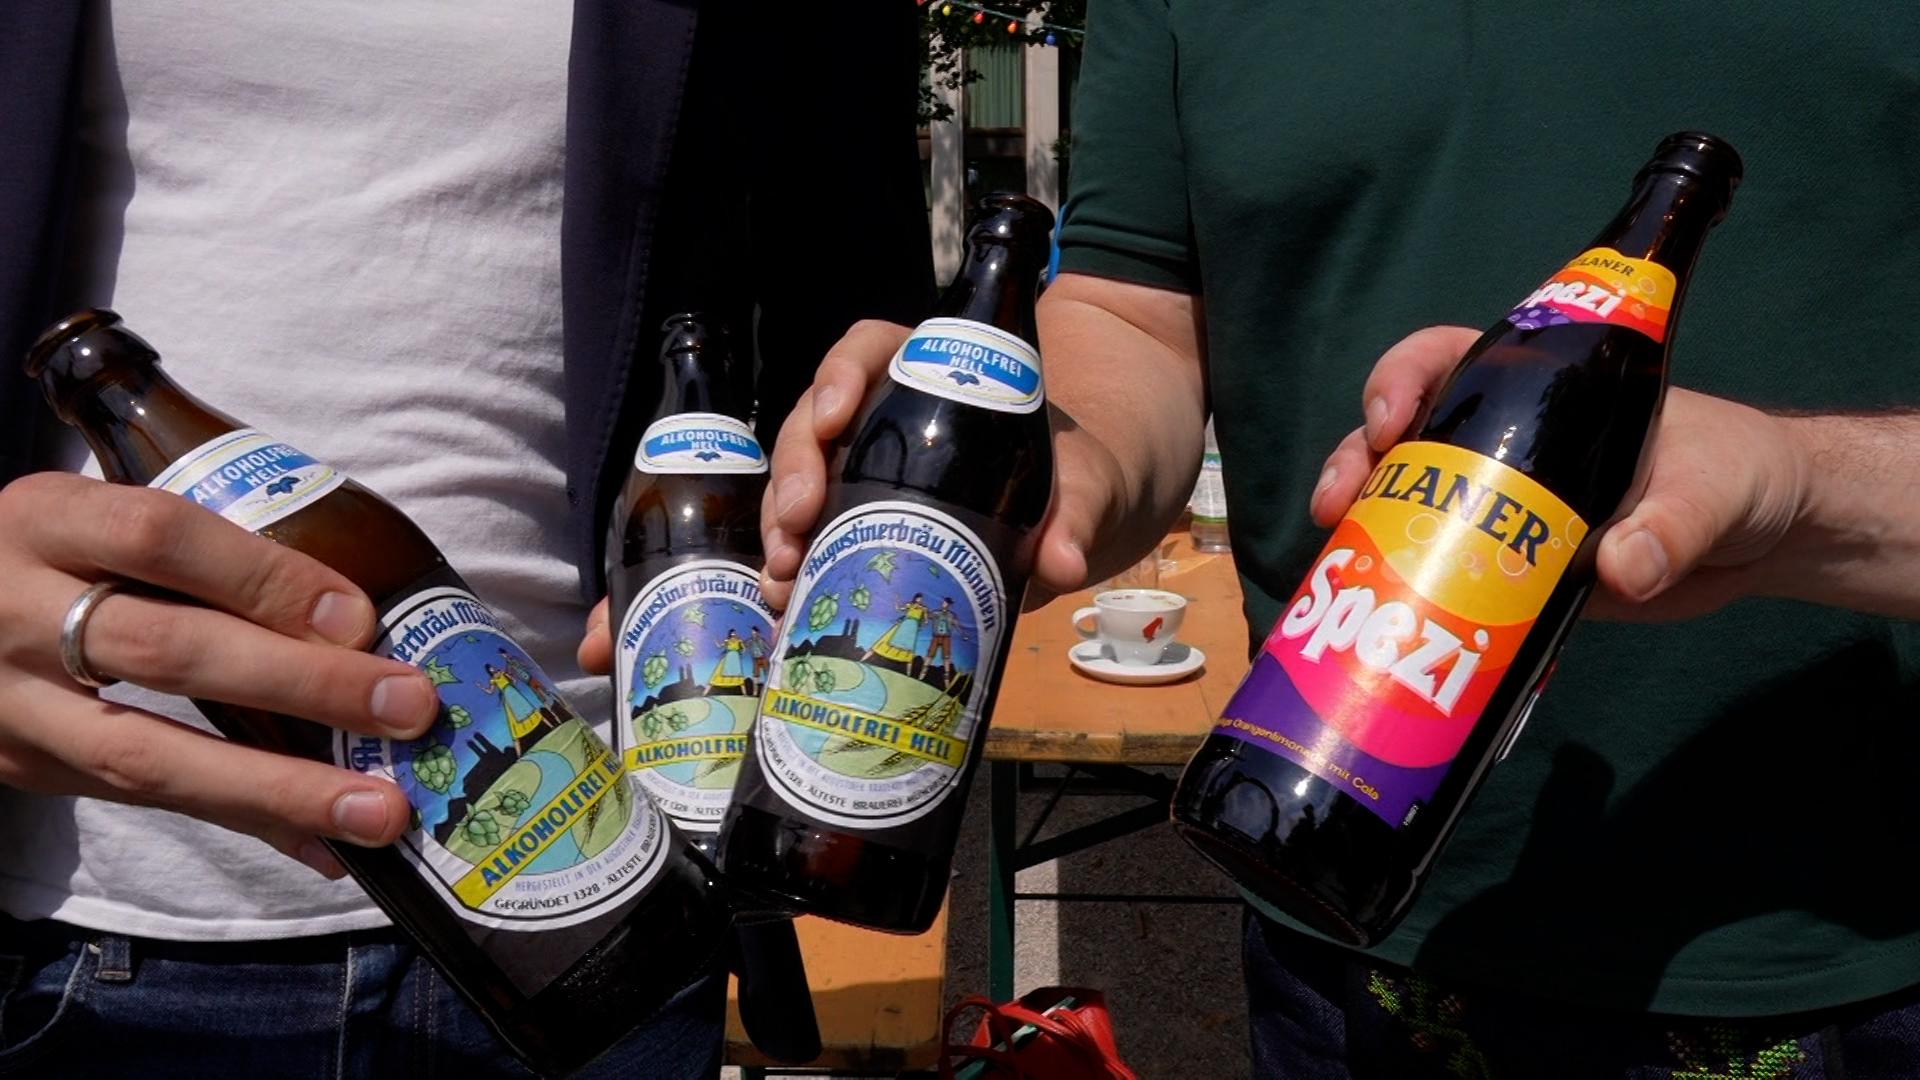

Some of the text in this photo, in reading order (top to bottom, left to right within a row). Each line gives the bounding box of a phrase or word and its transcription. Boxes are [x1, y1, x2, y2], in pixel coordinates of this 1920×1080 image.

[920, 338, 1023, 378] ALKOHOLFREI
[950, 355, 985, 375] HELL
[659, 430, 749, 448] ALKOHOLFREI
[691, 440, 721, 450] HELL
[244, 463, 289, 487] HELL
[804, 518, 946, 581] Augustinerbräu
[624, 573, 738, 651] Augustinerbräu
[1281, 549, 1489, 716] Spezi
[772, 695, 951, 760] ALKOHOLFREI HELL
[636, 737, 747, 765] ALKOHOLFRE
[1351, 776, 1380, 801] Cola
[480, 768, 608, 888] ALKOHOLFREI
[574, 883, 601, 901] 1328
